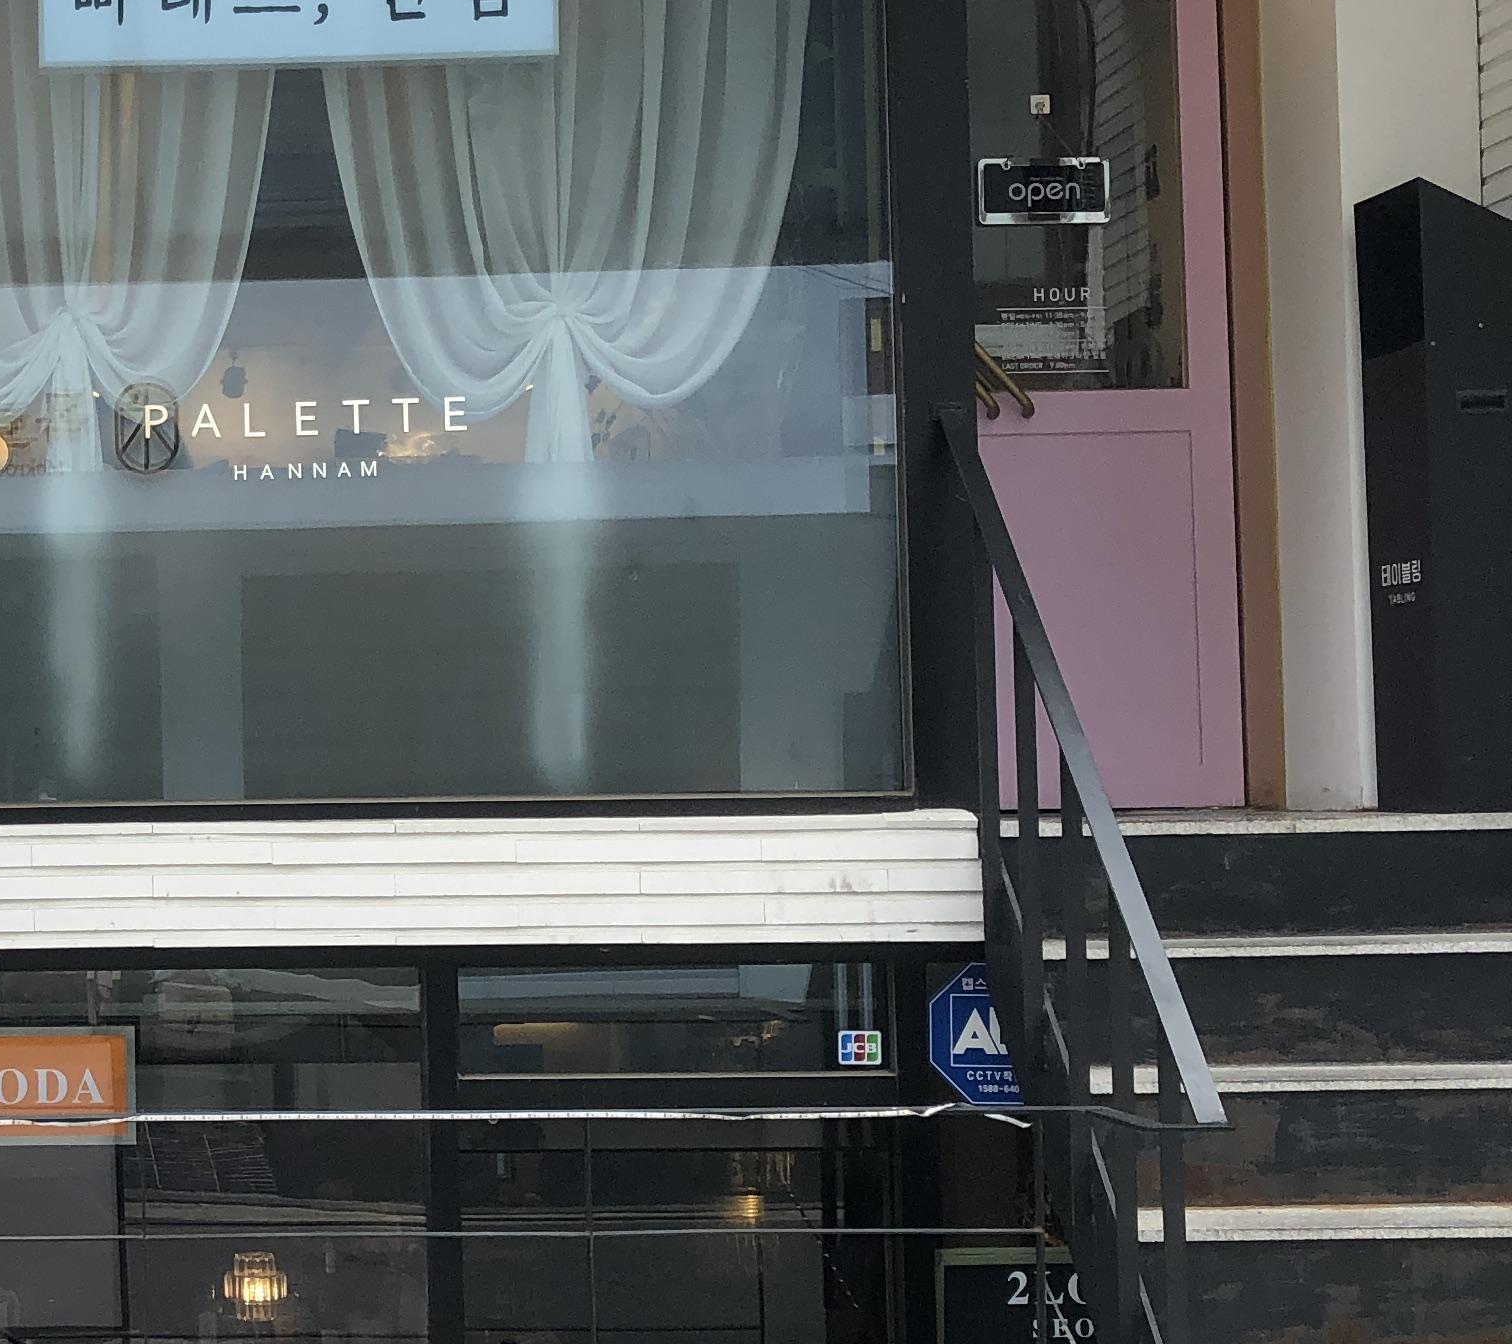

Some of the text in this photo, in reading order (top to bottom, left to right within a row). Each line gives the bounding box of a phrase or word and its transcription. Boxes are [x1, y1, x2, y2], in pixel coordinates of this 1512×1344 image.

[1008, 182, 1081, 208] open
[143, 395, 469, 440] PALETTE
[233, 459, 379, 482] HANNAM
[1381, 559, 1422, 587] 테이블링
